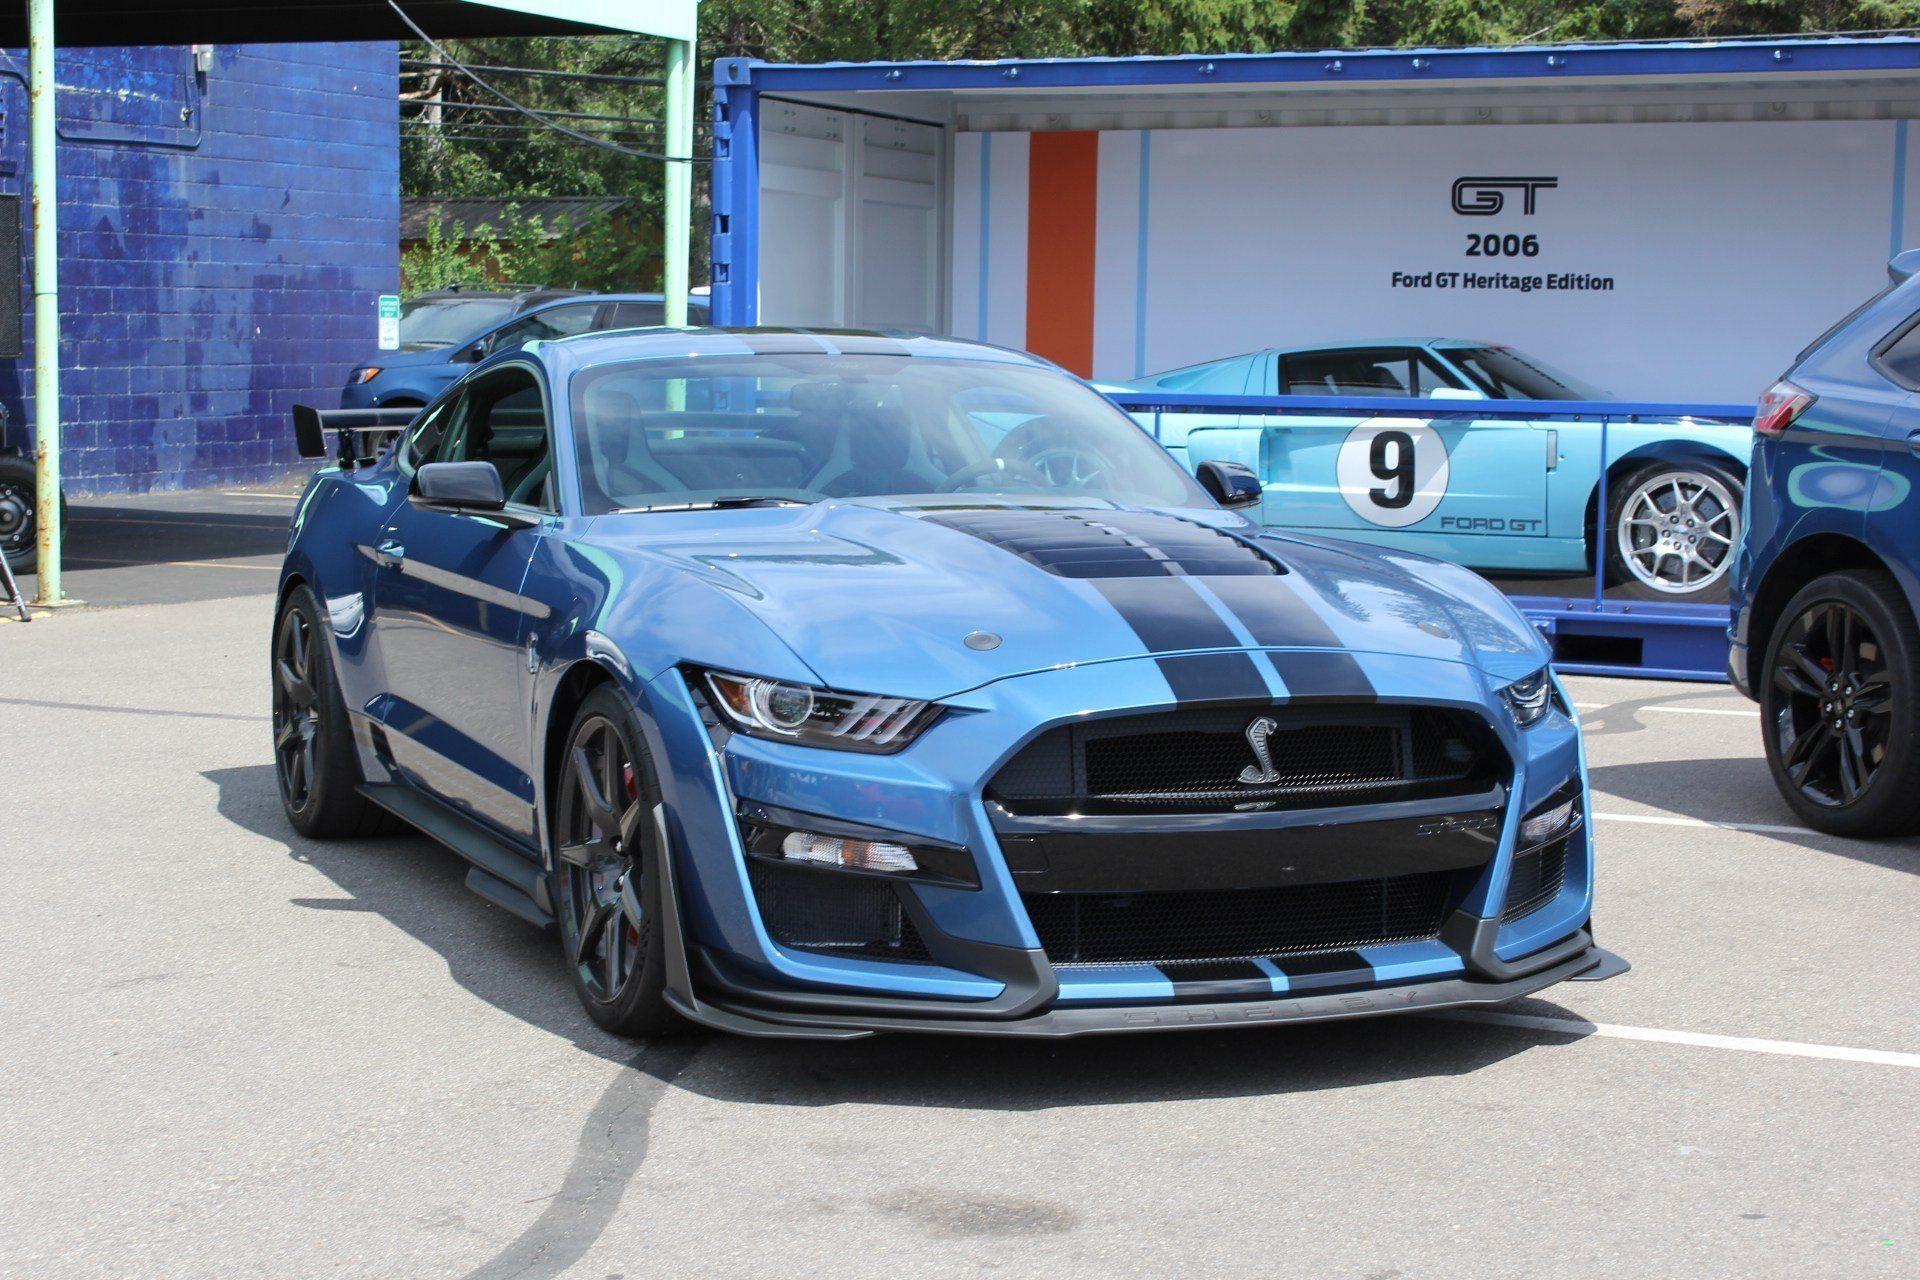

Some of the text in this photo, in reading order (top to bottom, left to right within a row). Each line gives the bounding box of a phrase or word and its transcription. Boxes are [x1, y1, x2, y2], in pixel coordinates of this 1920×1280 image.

[1451, 176, 1558, 216] GT
[1465, 233, 1540, 258] 2006
[1391, 271, 1614, 293] Ford GT Heritage Edition
[1369, 430, 1415, 509] 9
[1440, 516, 1543, 532] FORD GT
[1123, 990, 1418, 1024] SHELBY
